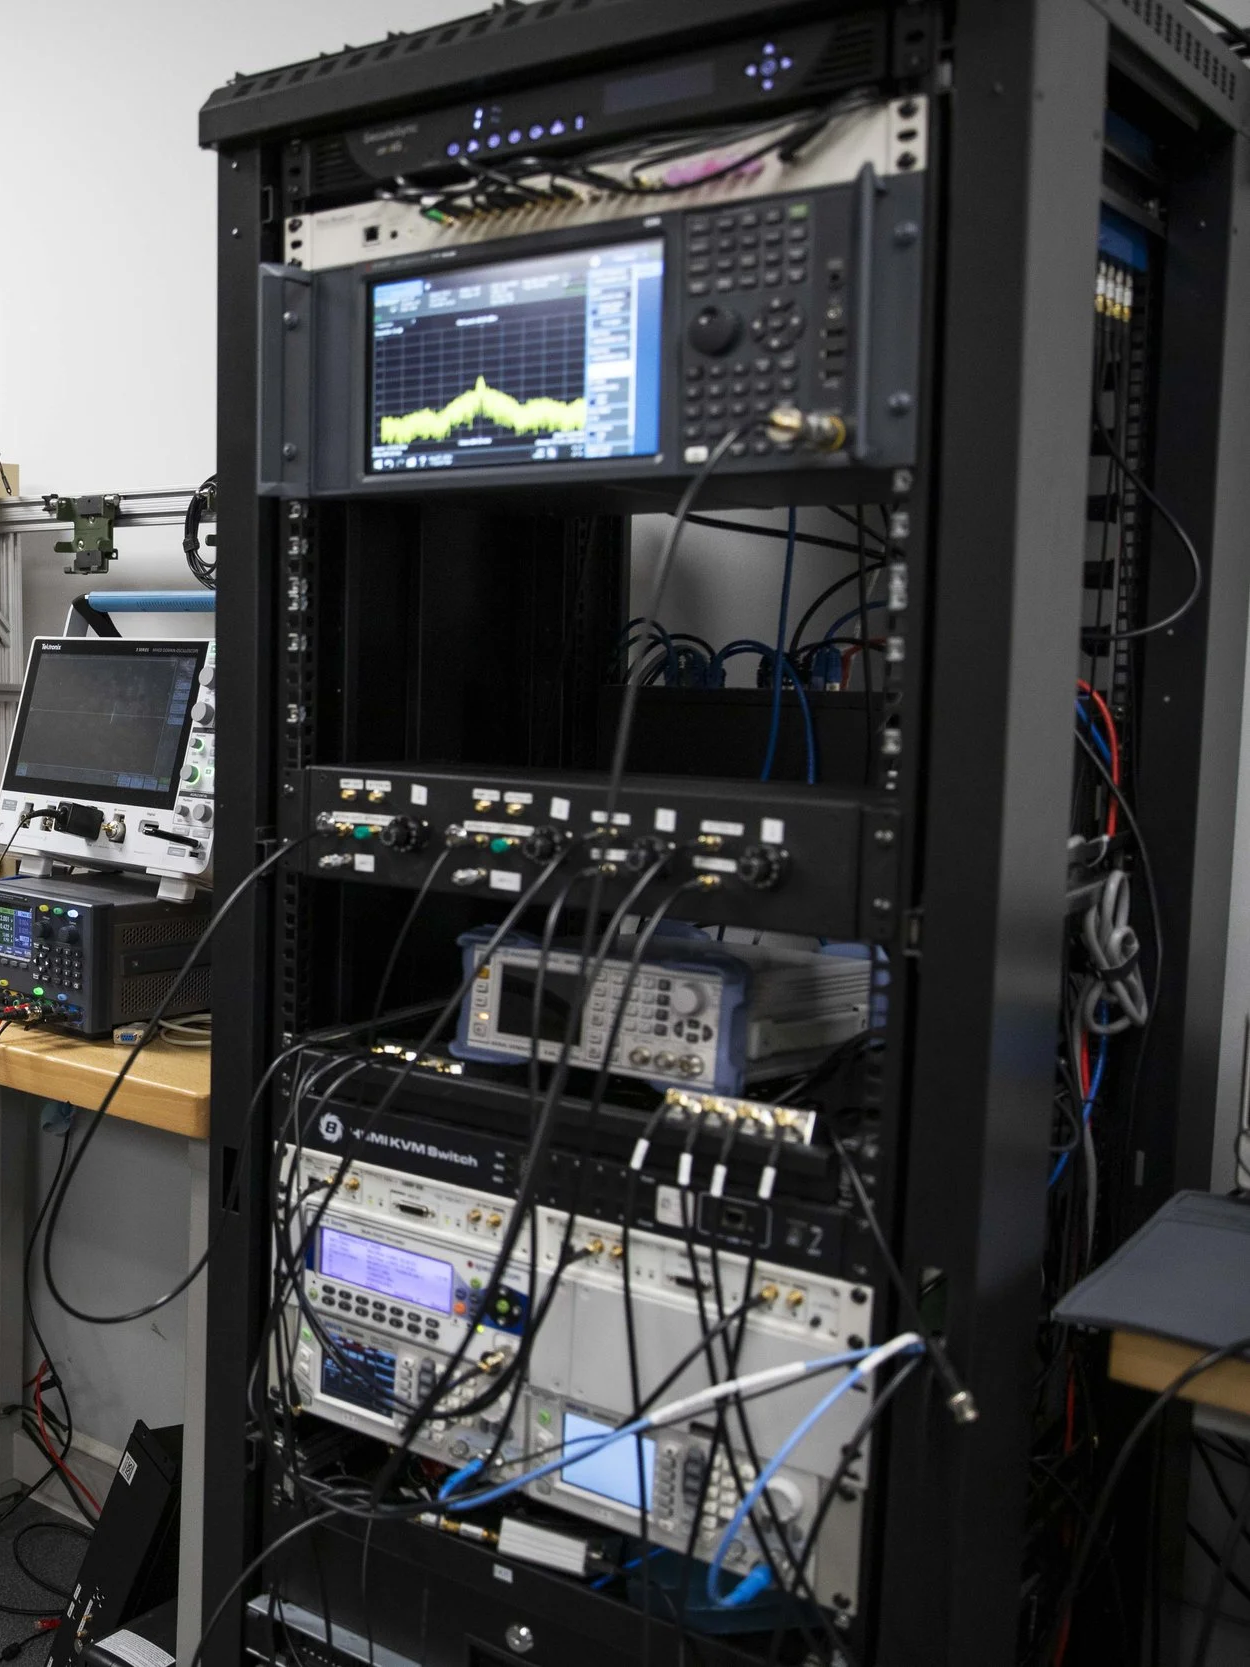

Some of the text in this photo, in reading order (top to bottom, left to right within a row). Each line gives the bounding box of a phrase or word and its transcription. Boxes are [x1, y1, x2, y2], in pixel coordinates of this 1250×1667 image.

[41, 643, 62, 651] Tektronix
[325, 1121, 479, 1168] 8 HMI KVM Switch
